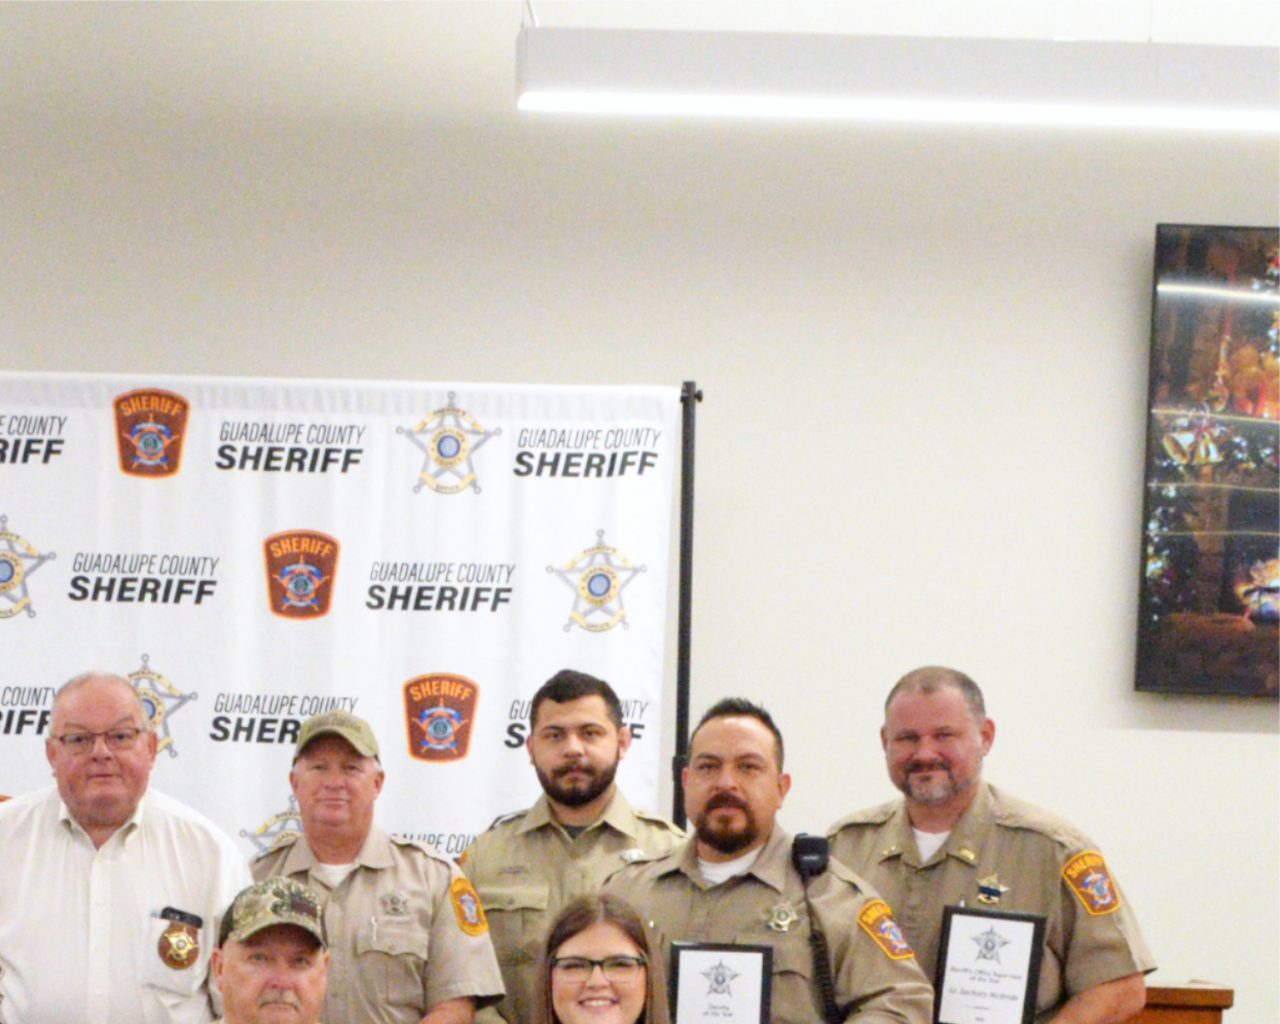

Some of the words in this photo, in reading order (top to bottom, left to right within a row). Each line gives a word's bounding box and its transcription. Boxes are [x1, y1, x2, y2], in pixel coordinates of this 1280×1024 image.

[120, 395, 182, 417] SHERIFF
[7, 415, 67, 436] COUNTY
[220, 421, 304, 443] GUADALUPE
[306, 423, 365, 444] COUNTY
[518, 428, 602, 449] GUADALUPE
[604, 428, 661, 449] COUNTY
[215, 445, 363, 473] SHERIFF
[513, 451, 658, 477] SHERIFF
[270, 537, 333, 558] SHERIFF
[73, 552, 158, 574] GUADALUPE
[159, 554, 219, 576] COUNTY
[370, 562, 454, 583] GUADALUPE
[456, 563, 516, 584] COUNTY
[68, 576, 217, 604] SHERIFF
[366, 585, 512, 612] SHERIFF
[410, 680, 472, 701] SHERIFF
[214, 693, 298, 715] GUADALUPE
[209, 716, 300, 743] SHER
